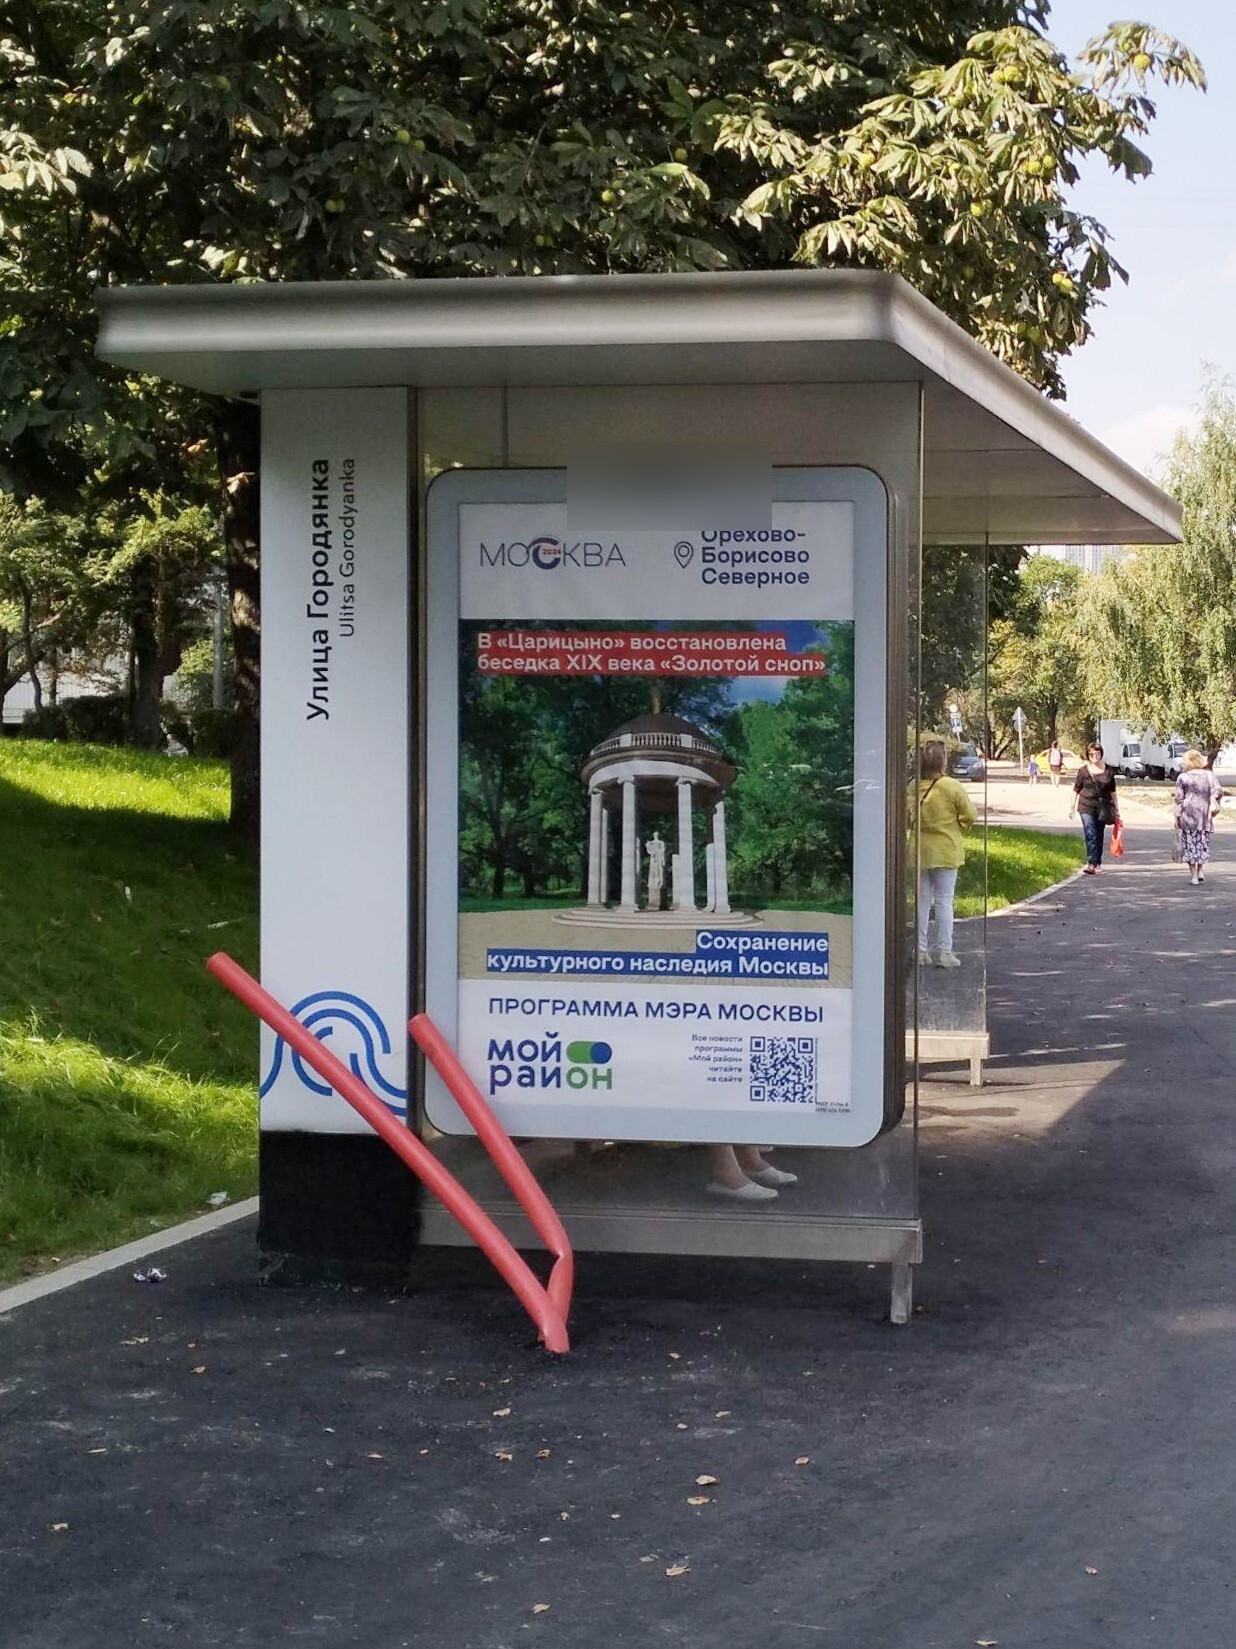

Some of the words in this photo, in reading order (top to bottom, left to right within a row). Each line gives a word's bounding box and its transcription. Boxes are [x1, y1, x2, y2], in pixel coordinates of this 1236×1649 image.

[338, 457, 359, 578] Gorodyanka
[306, 458, 334, 619] Городянка
[701, 530, 807, 547] Орехово-
[479, 536, 627, 570] МОСКВА
[701, 546, 810, 568] Борисово
[701, 567, 810, 589] Северное
[338, 583, 355, 637] Ulitsa
[477, 633, 492, 650] В
[497, 633, 624, 652] «Царицыно»
[630, 637, 786, 651] восстановлена
[306, 628, 333, 721] Улица
[477, 654, 560, 672] беседка
[566, 655, 602, 671] XIX
[608, 658, 655, 672] века
[660, 654, 760, 672] «Золотой
[765, 659, 826, 673] сноп»
[696, 931, 829, 953] Сохранение
[487, 953, 625, 973] культурного
[630, 957, 732, 976] наследия
[738, 956, 829, 976] Москвы
[488, 998, 639, 1018] ПРОГРАММА
[645, 1002, 712, 1020] МЭРА
[718, 1003, 824, 1023] МОСКВЫ
